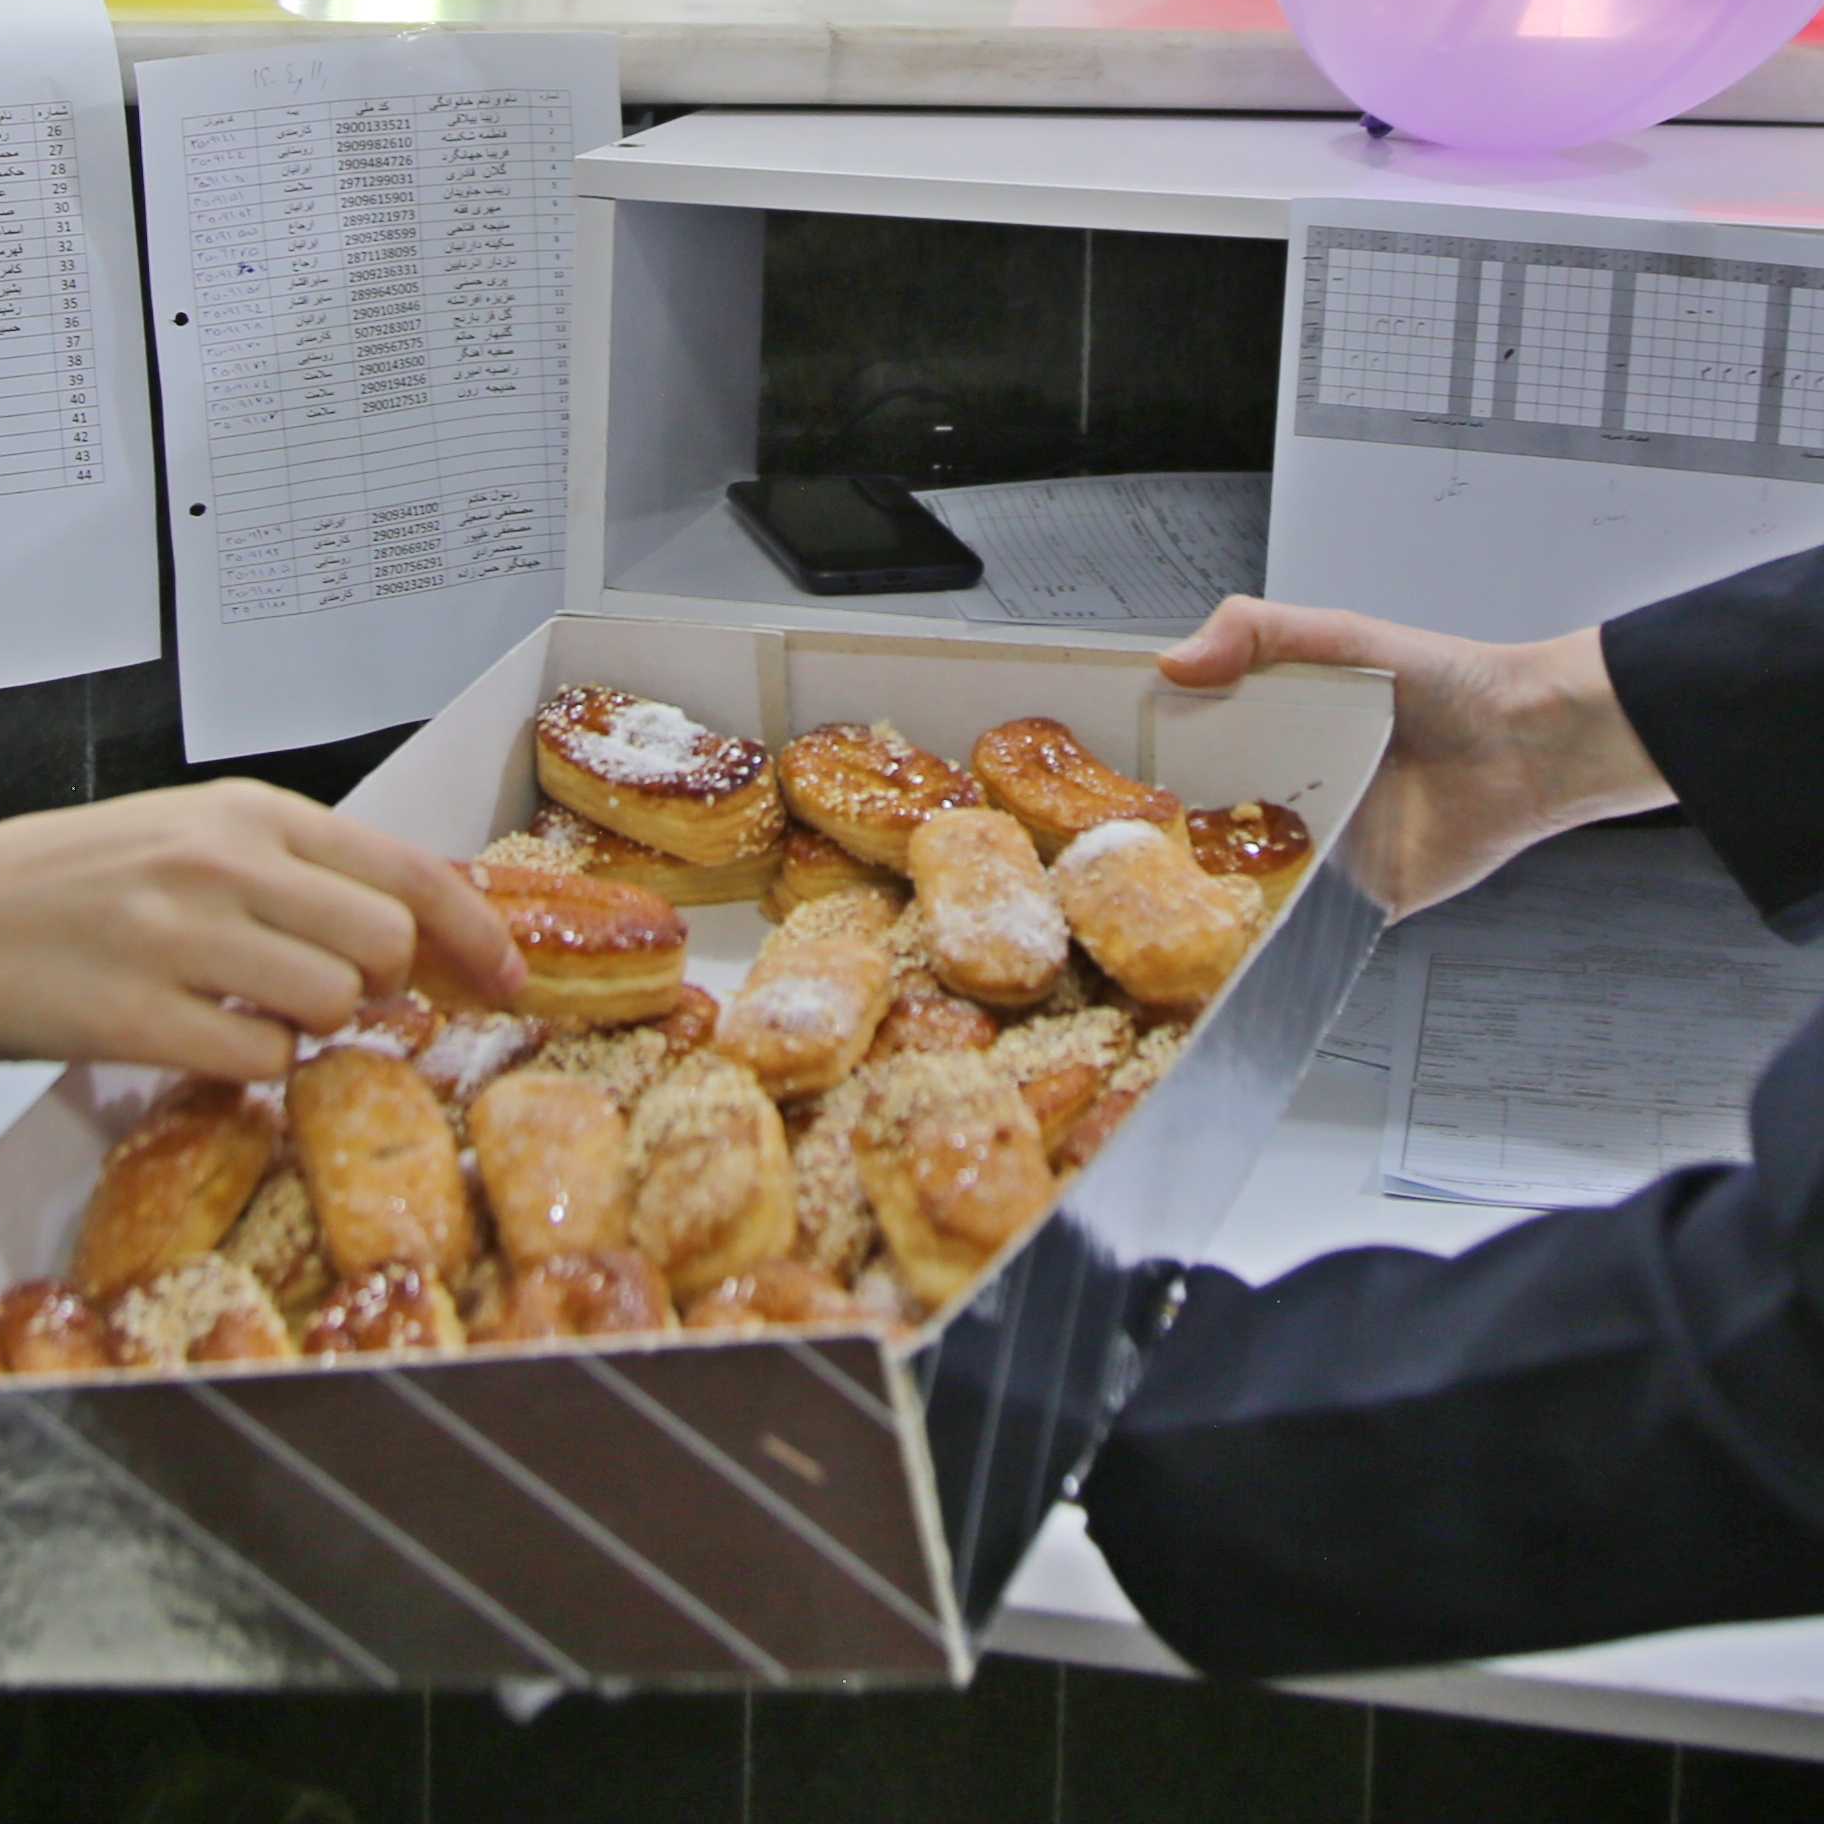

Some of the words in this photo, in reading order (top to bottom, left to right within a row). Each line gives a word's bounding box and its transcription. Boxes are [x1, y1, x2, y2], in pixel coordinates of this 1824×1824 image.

[46, 124, 63, 138] 26
[335, 118, 411, 135] 2900133521
[48, 143, 64, 157] 27
[336, 136, 413, 153] 2909982610
[50, 162, 67, 176] 28
[338, 154, 414, 171] 2909484726
[52, 182, 68, 195] 29
[339, 173, 414, 190] 2971299031
[54, 201, 70, 214] 30
[341, 191, 415, 209] 2909615901
[56, 221, 72, 233] 31
[343, 209, 416, 228] 2899221973
[344, 227, 417, 246] 2909258599
[58, 239, 74, 253] 32
[347, 245, 418, 265] 2871138095
[59, 259, 76, 272] 33
[349, 263, 419, 283] 2909236331
[61, 278, 77, 291] 34
[350, 281, 420, 302] 2899645005
[63, 297, 79, 310] 35
[352, 299, 421, 321] 2909103846
[64, 316, 80, 329] 36
[354, 318, 422, 340] 5079283017
[66, 335, 81, 348] 37
[356, 336, 424, 358] 2909567575
[67, 354, 83, 368] 38
[358, 355, 425, 377] 2900143500
[68, 373, 85, 387] 39
[360, 373, 427, 395] 2909194256
[69, 392, 86, 405] 40
[362, 391, 428, 414] 2900127513
[71, 412, 88, 424] 41
[73, 430, 89, 443] 42
[74, 450, 91, 462] 43
[76, 469, 93, 481] 44
[371, 501, 439, 524] 2909341100
[372, 519, 441, 542] 2909147592
[373, 537, 442, 560] 2870669267
[374, 556, 444, 578] 2870756291
[375, 574, 445, 597] 2909232913
